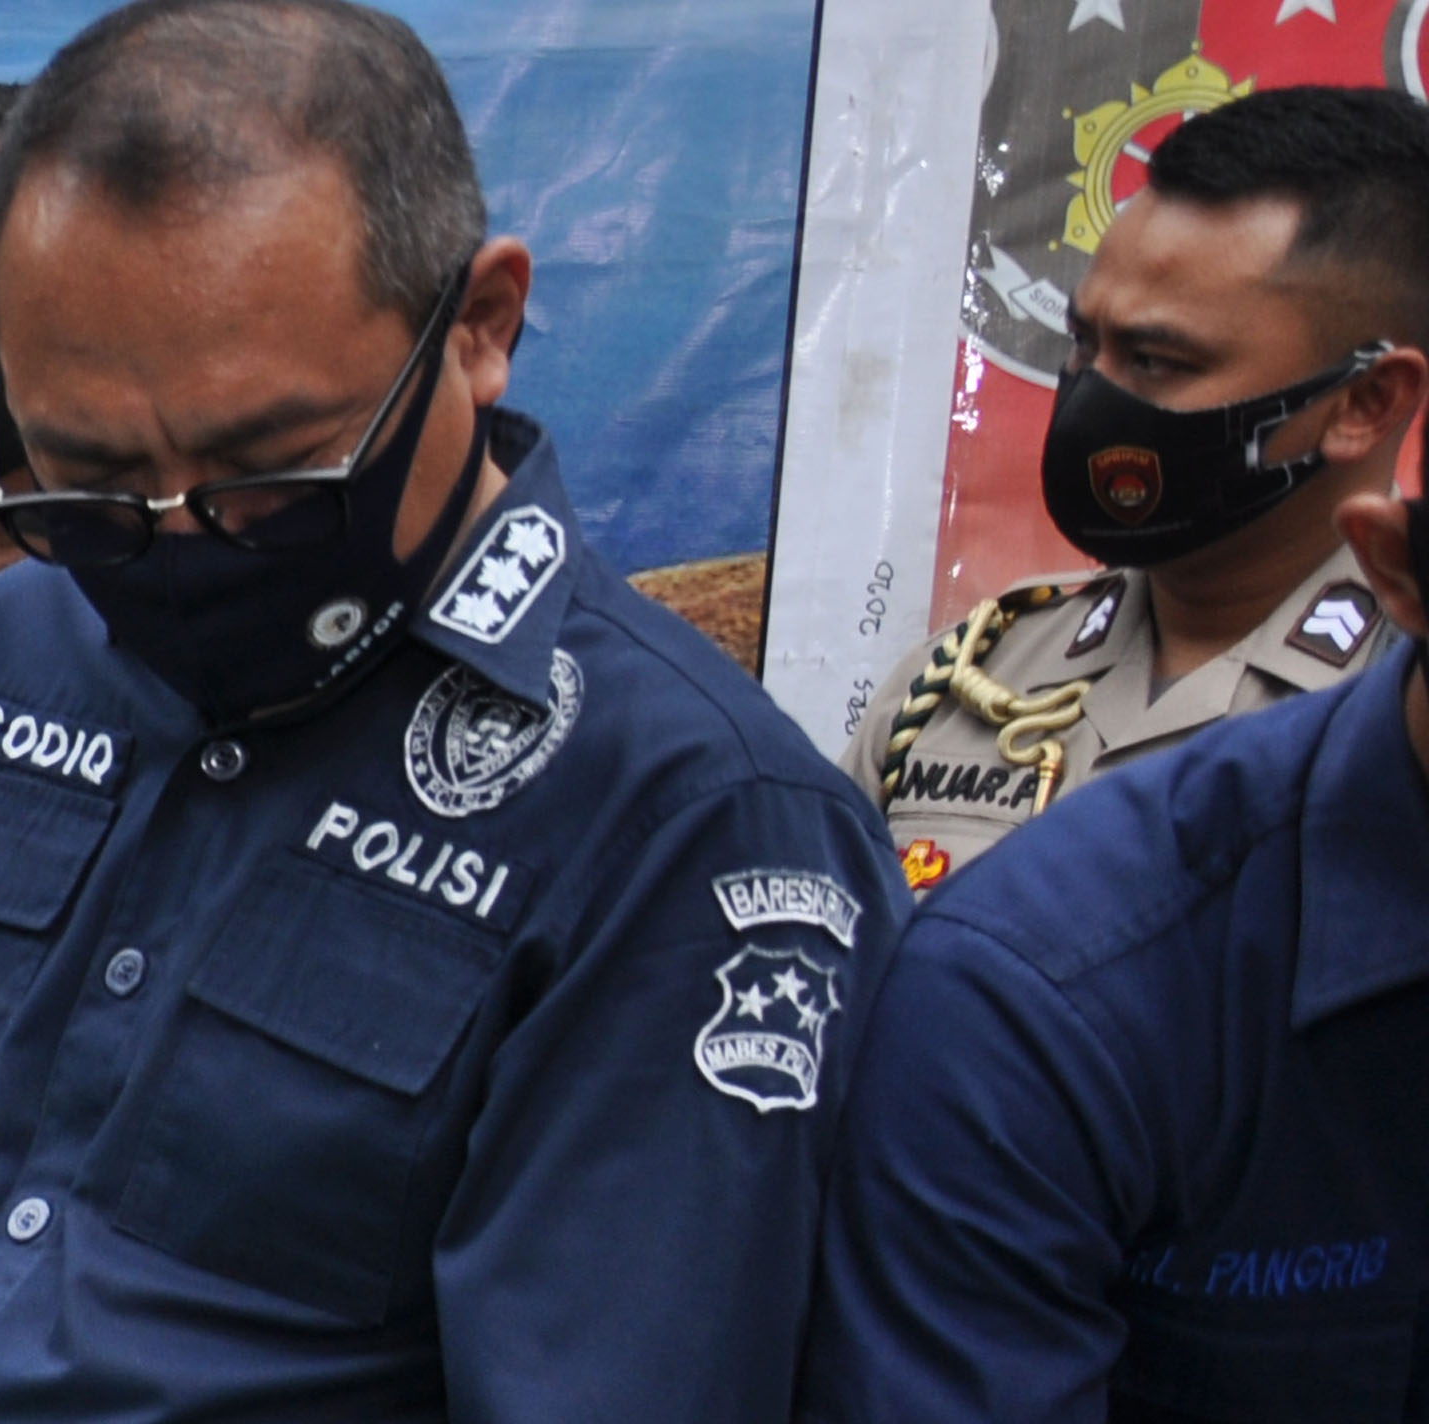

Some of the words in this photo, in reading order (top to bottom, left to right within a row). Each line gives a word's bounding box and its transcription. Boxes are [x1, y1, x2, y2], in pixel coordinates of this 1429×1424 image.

[859, 560, 895, 636] 2020
[305, 801, 510, 918] POLISI
[704, 1039, 778, 1068] MABES
